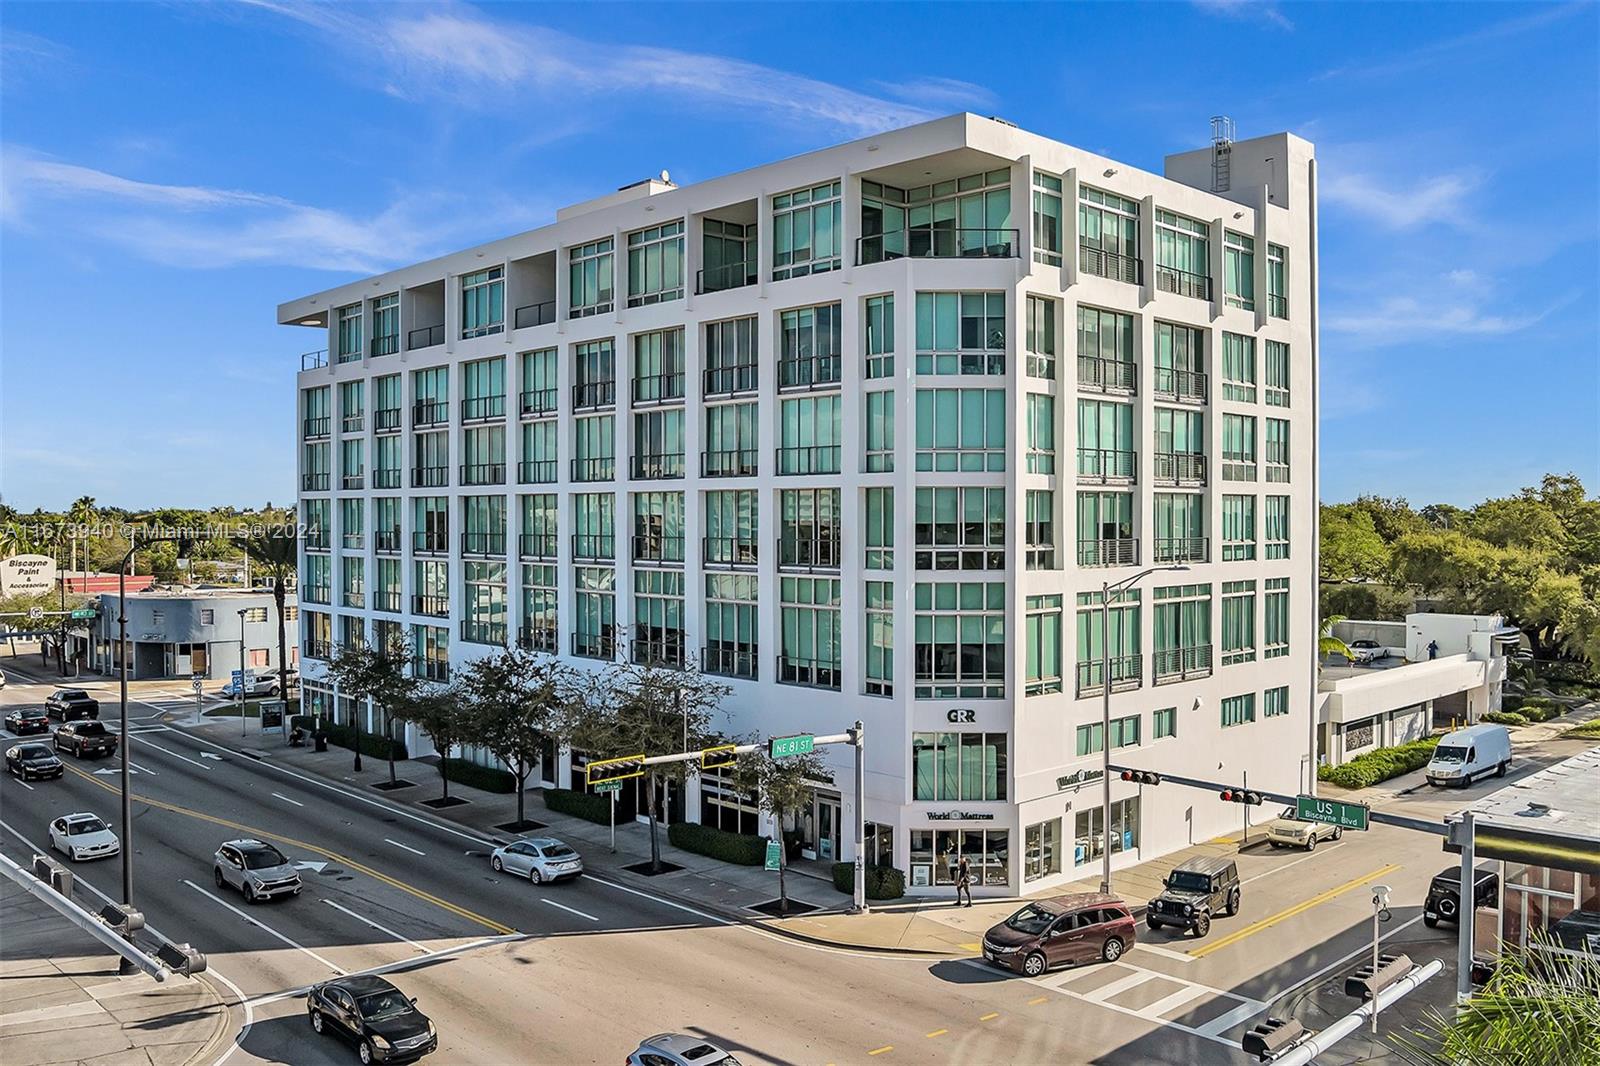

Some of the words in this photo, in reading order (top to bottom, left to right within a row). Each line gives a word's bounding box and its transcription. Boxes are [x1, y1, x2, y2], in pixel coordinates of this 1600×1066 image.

[9, 559, 49, 568] Biscayne
[18, 568, 39, 576] Paint
[776, 743, 787, 753] NE
[789, 741, 798, 752] 81
[800, 740, 810, 750] ST
[1316, 802, 1333, 814] US
[1341, 806, 1346, 817] 1
[927, 811, 950, 820] World
[960, 811, 994, 820] Mattress
[1305, 810, 1336, 822] Biscayne
[1341, 816, 1358, 826] Blvd
